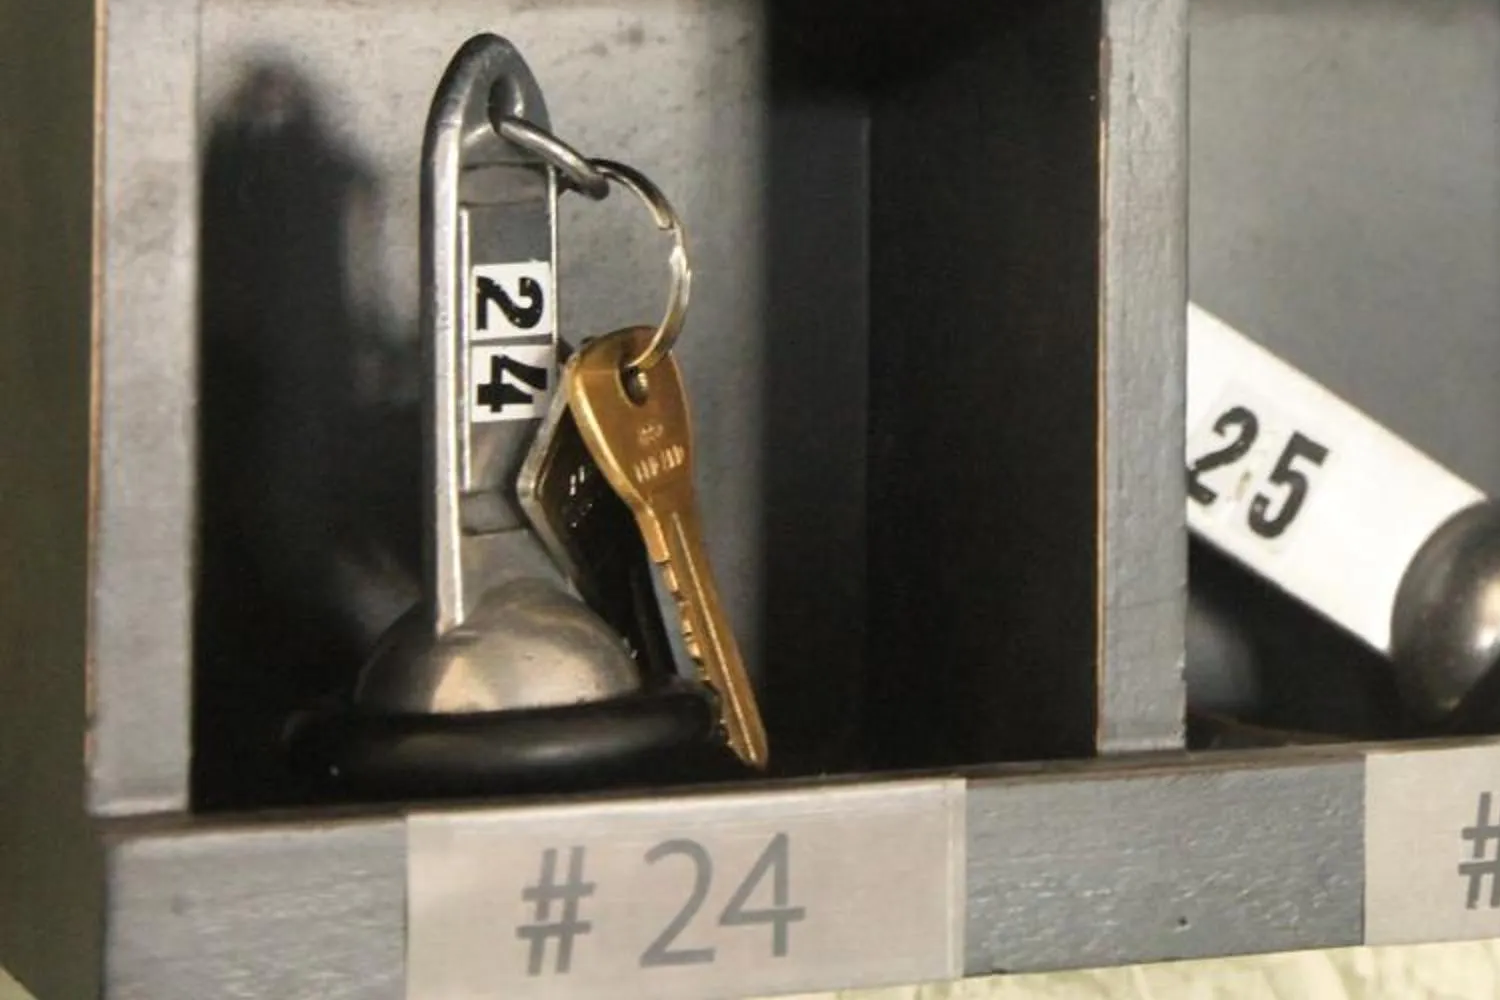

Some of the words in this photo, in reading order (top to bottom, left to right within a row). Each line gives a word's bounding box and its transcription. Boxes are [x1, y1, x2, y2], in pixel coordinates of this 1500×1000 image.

[475, 275, 548, 414] 24
[1187, 405, 1330, 540] 25
[639, 832, 806, 969] 24
